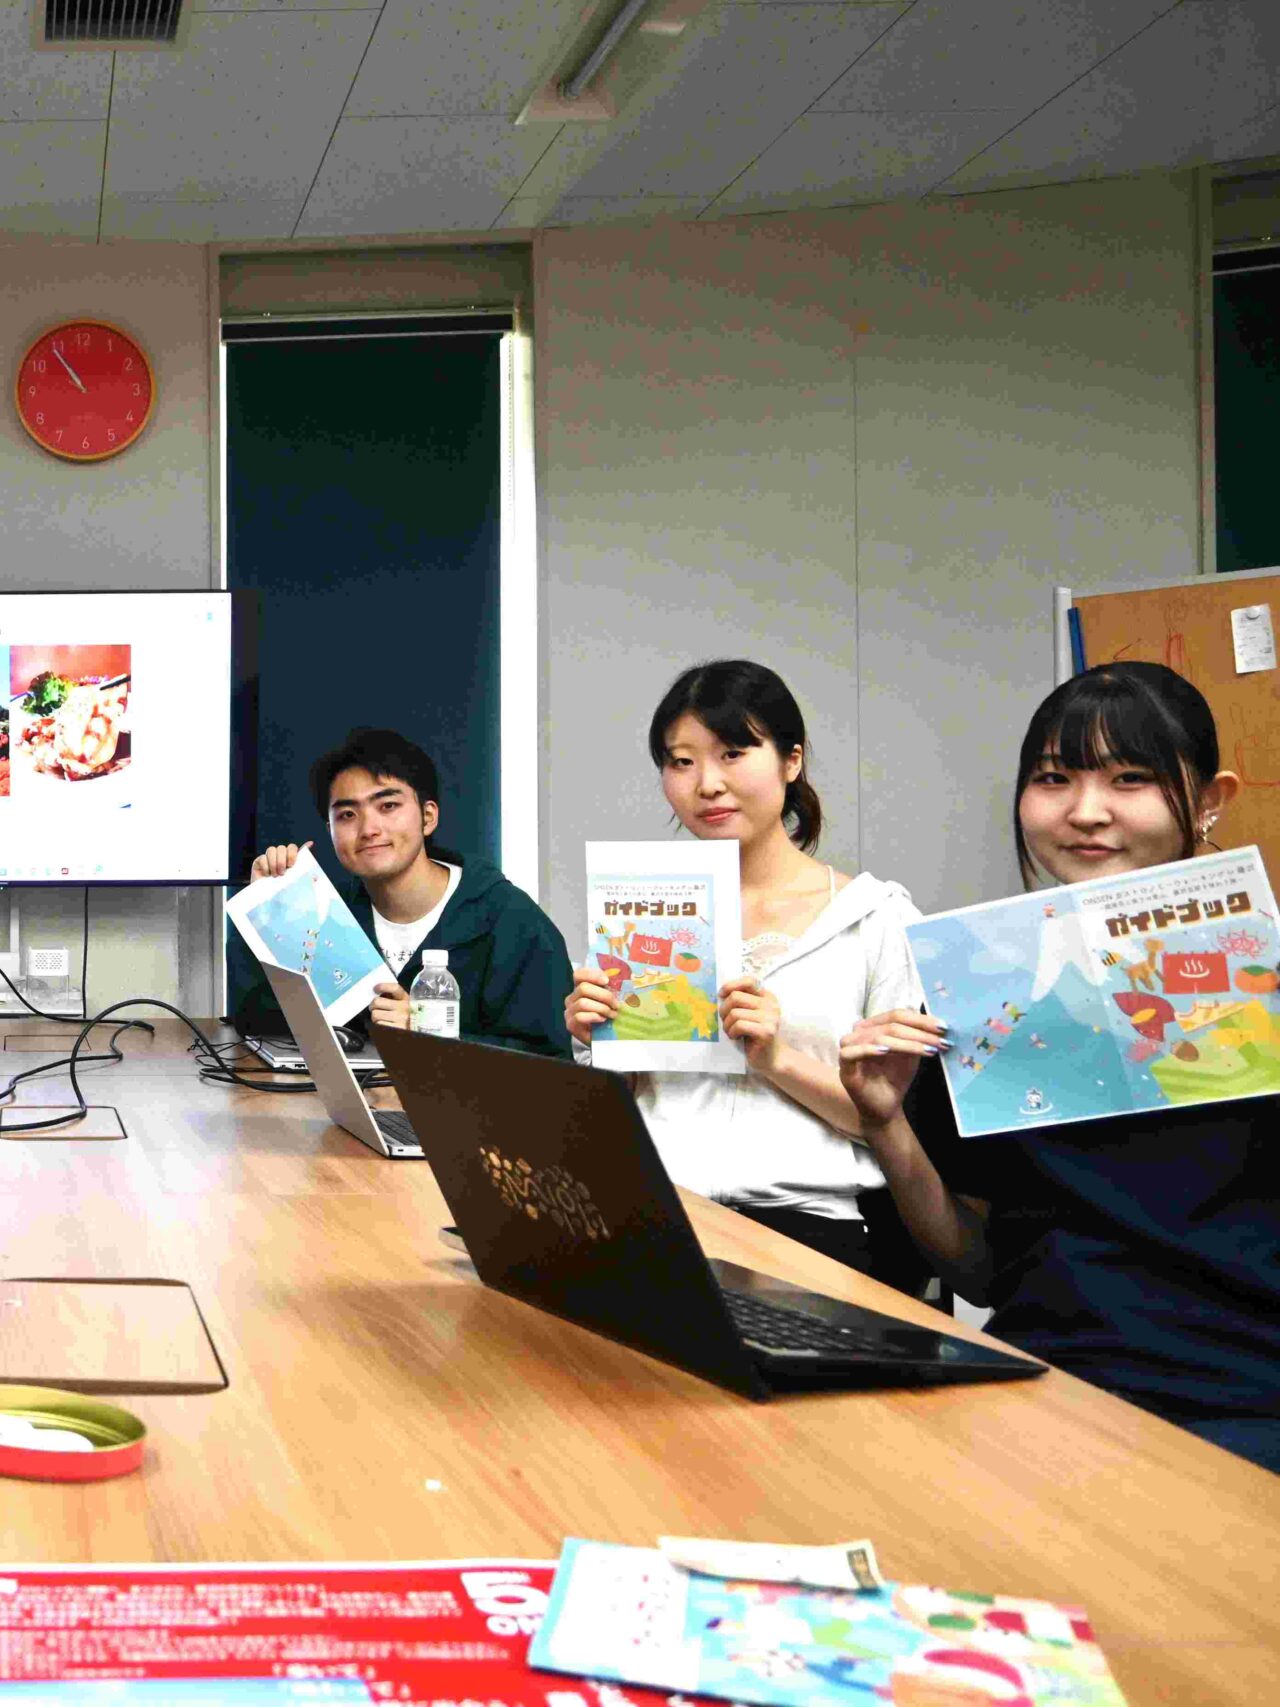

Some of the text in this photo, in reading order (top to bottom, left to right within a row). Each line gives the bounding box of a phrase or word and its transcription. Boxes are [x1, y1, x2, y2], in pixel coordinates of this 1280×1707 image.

[77, 333, 91, 346] 12
[32, 360, 46, 372] 10
[125, 358, 133, 371] 2
[29, 386, 36, 397] 9
[132, 384, 140, 396] 3
[36, 412, 44, 424] 8
[126, 410, 133, 421] 4
[56, 430, 63, 442] 7
[107, 429, 115, 441] 5
[82, 437, 89, 448] 6
[604, 899, 696, 916] ガイドブック
[1105, 891, 1252, 938] ガイドブック
